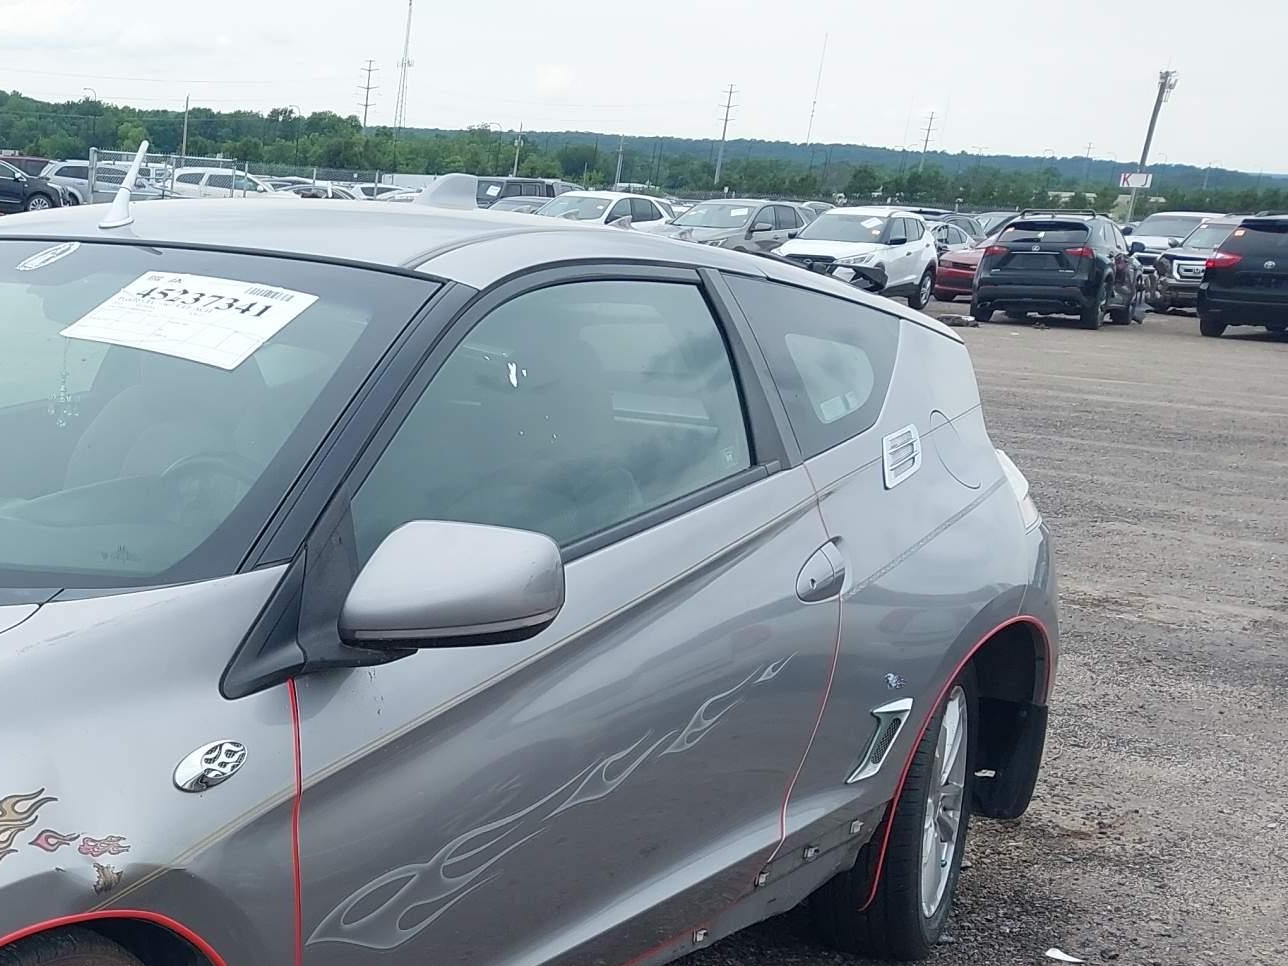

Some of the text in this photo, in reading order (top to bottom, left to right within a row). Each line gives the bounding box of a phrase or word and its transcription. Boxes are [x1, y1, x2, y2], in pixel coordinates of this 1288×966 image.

[1121, 173, 1149, 186] K J
[136, 286, 273, 318] 45237341
